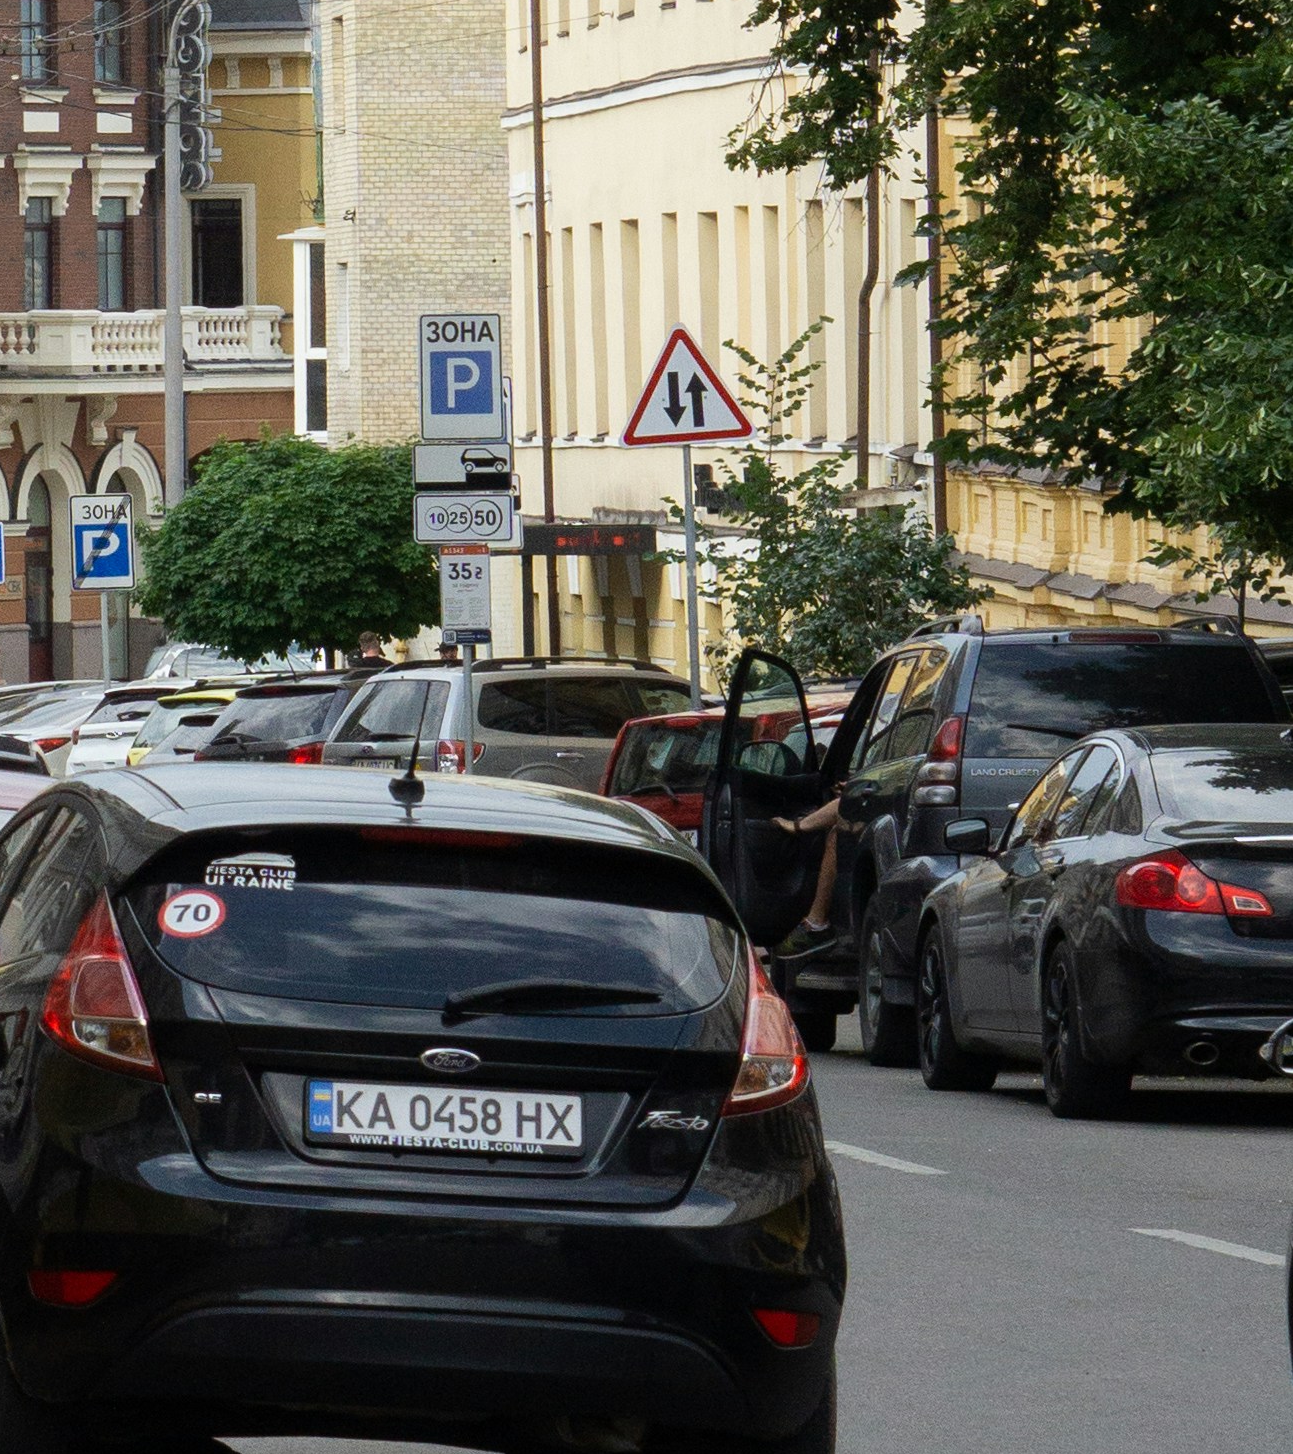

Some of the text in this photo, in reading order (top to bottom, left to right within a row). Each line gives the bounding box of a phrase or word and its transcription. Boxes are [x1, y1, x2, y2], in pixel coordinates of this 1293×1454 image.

[426, 320, 494, 344] ЗОНА
[81, 504, 128, 519] ЗОНА
[429, 505, 497, 527] 10 25 50
[970, 767, 997, 776] LAND
[206, 865, 297, 879] FIESTA CLUB
[173, 903, 212, 923] 70
[431, 1051, 468, 1069] Ford
[193, 1092, 222, 1104] SE
[313, 1114, 332, 1128] UA
[335, 1089, 575, 1142] KA 0458 HX
[637, 1110, 710, 1131] Fiesta
